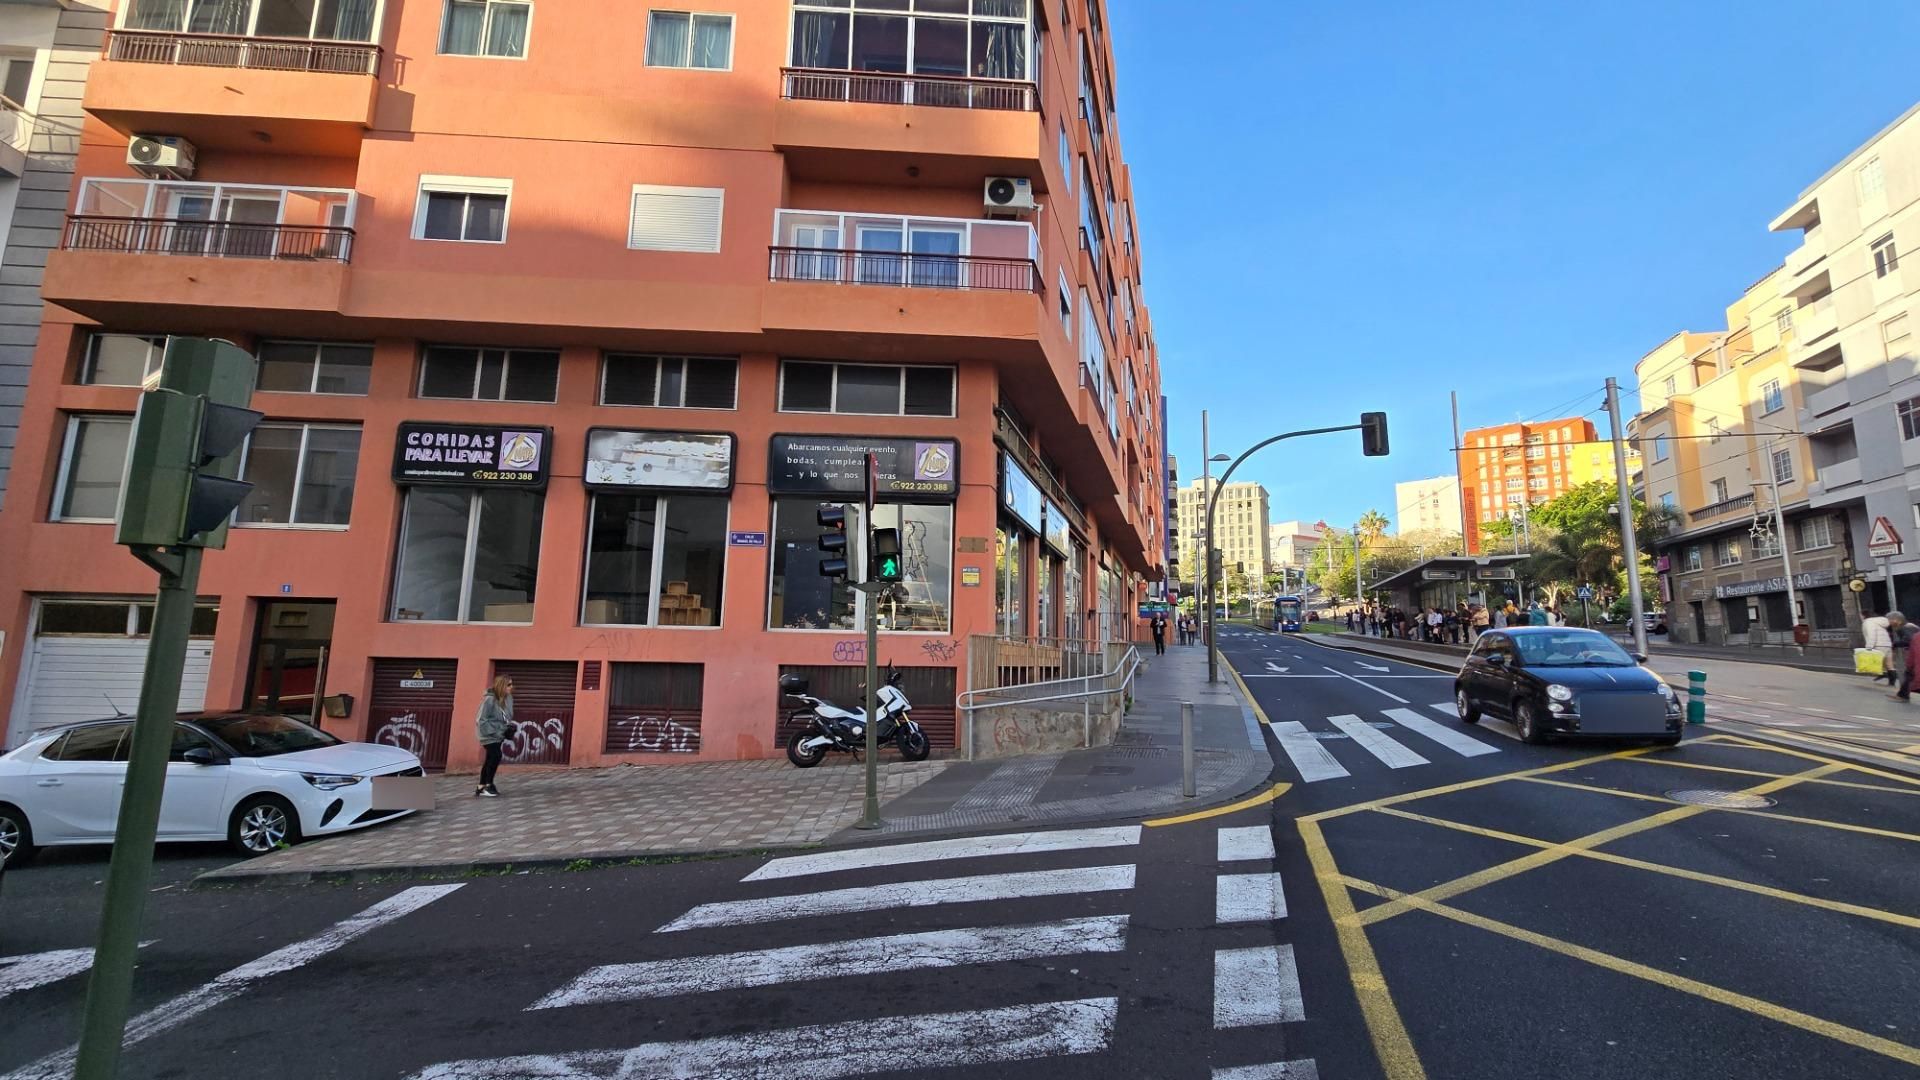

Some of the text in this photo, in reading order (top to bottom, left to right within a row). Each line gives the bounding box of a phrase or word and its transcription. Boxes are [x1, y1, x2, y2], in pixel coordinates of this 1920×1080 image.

[407, 432, 495, 447] COMIDAS
[787, 443, 831, 451] Abarcamos
[832, 444, 868, 454] cualquier
[404, 447, 442, 462] PARA
[444, 448, 494, 464] LLEVAR
[483, 472, 533, 481] 922 230 388
[799, 471, 805, 480] y
[810, 469, 818, 478] lo
[823, 472, 839, 480] que
[900, 482, 948, 491] 922 230 388
[1726, 583, 1765, 596] Restaurante
